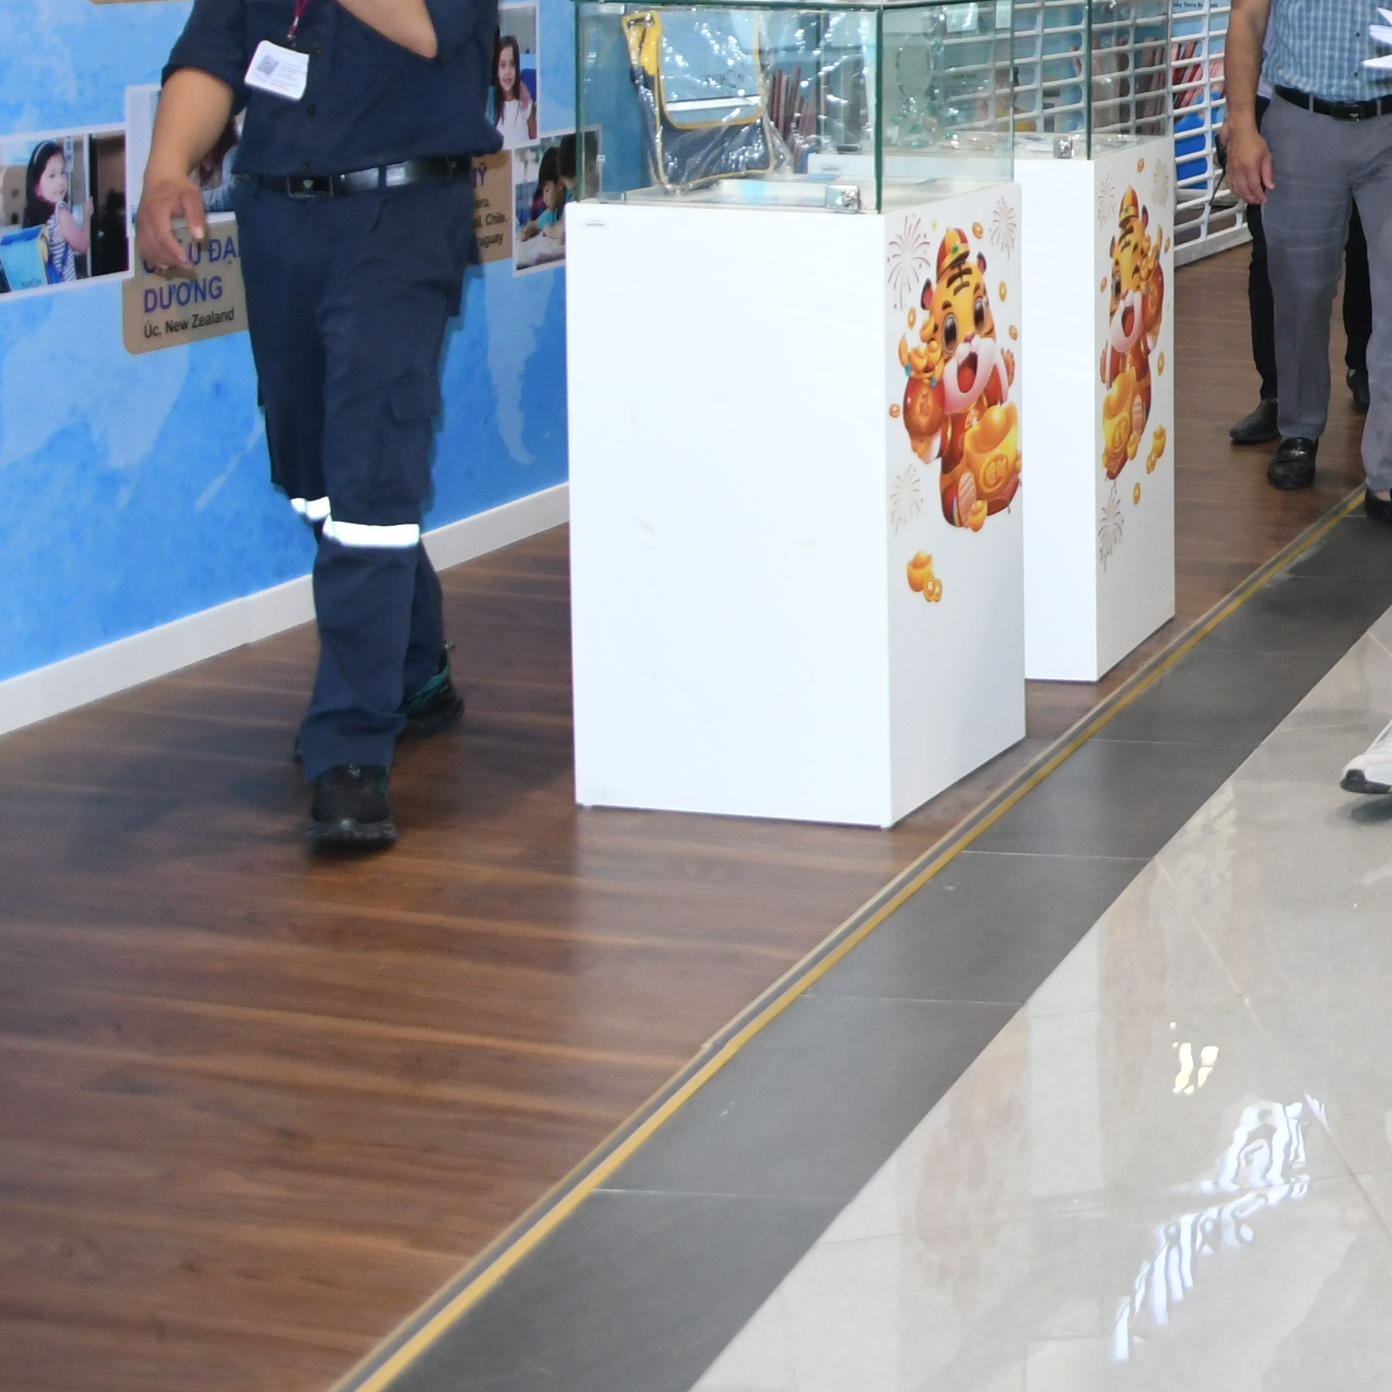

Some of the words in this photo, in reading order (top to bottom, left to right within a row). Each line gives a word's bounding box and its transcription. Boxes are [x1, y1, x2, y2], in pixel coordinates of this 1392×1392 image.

[144, 275, 223, 314] DƯƠNG
[165, 319, 189, 333] New
[191, 306, 235, 329] Zealand
